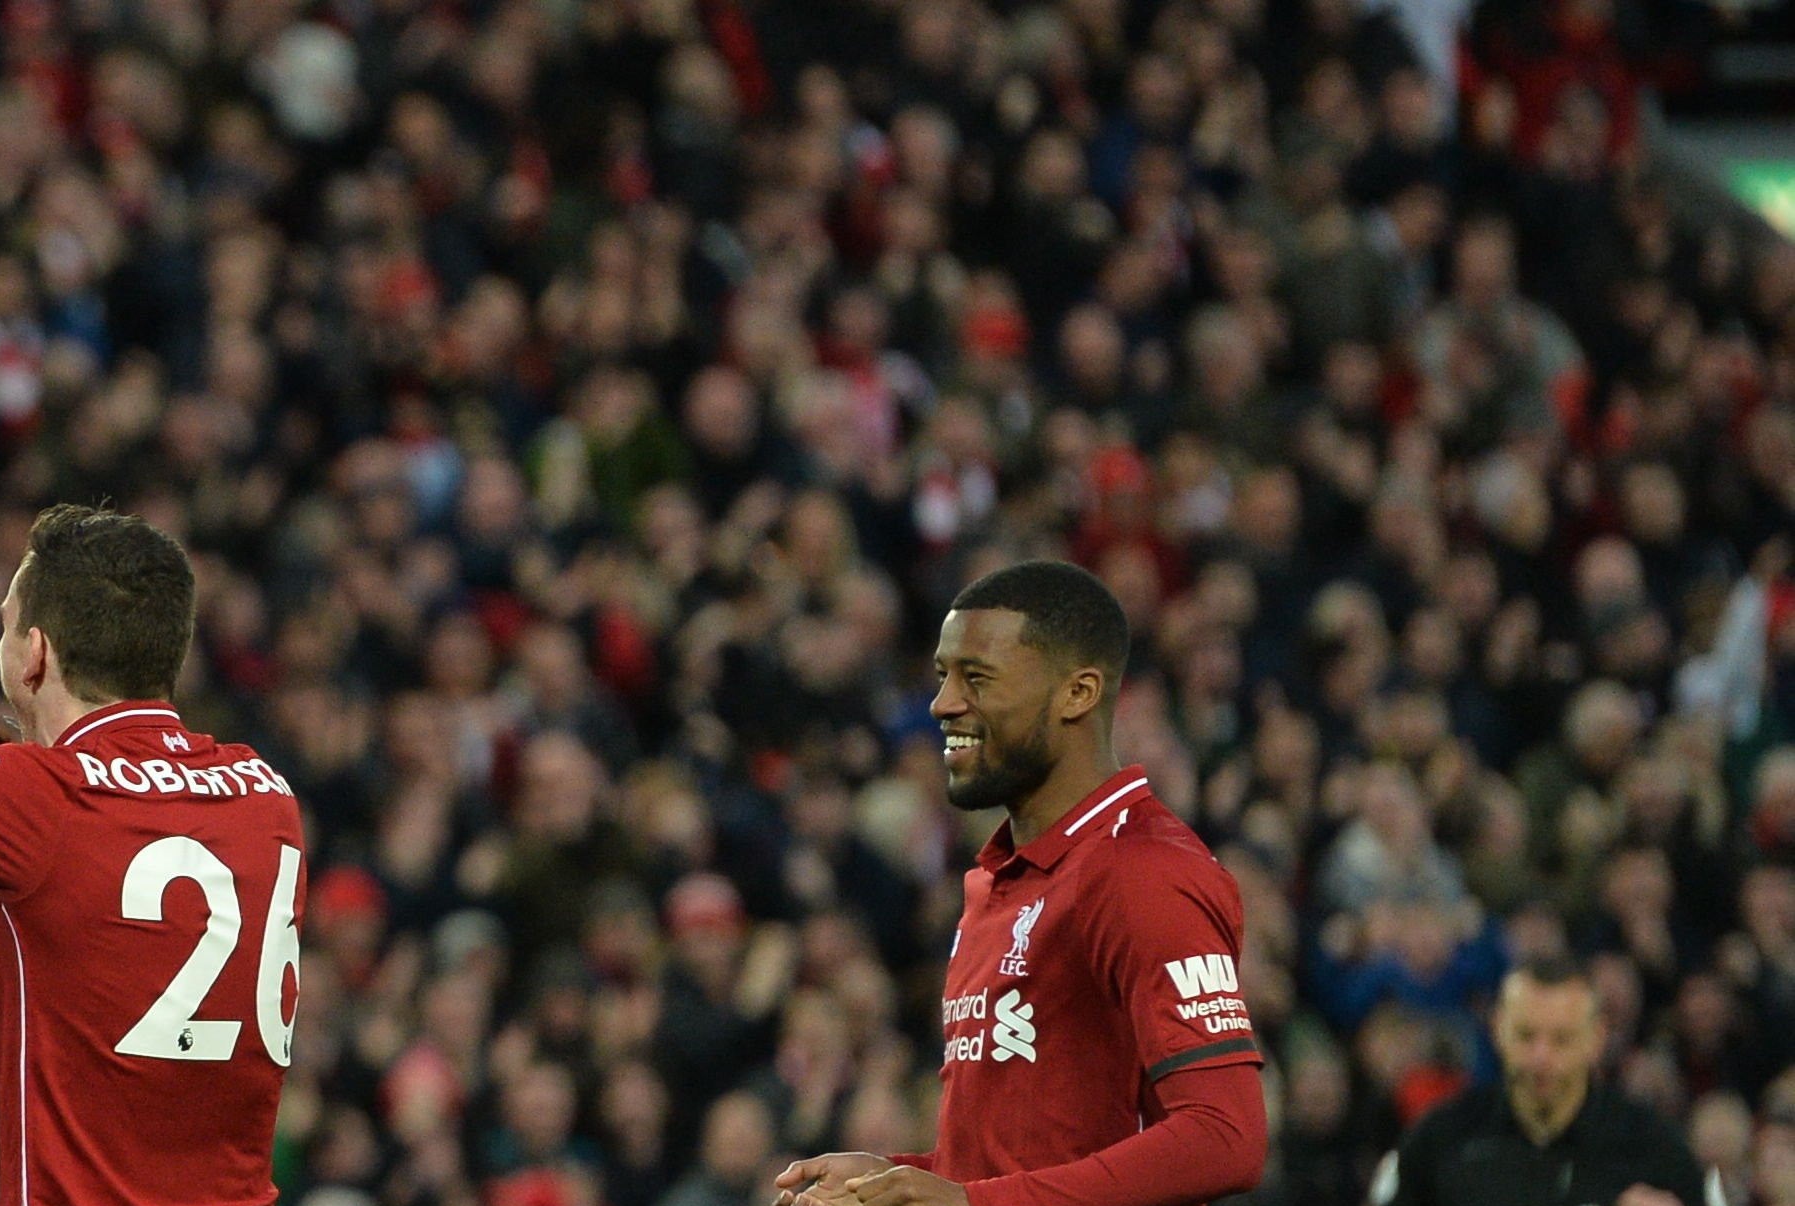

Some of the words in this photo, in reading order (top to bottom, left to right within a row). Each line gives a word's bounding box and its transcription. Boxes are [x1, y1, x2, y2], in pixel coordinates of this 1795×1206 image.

[113, 835, 302, 1068] 26
[1164, 953, 1239, 1000] WU
[942, 987, 988, 1025] andard
